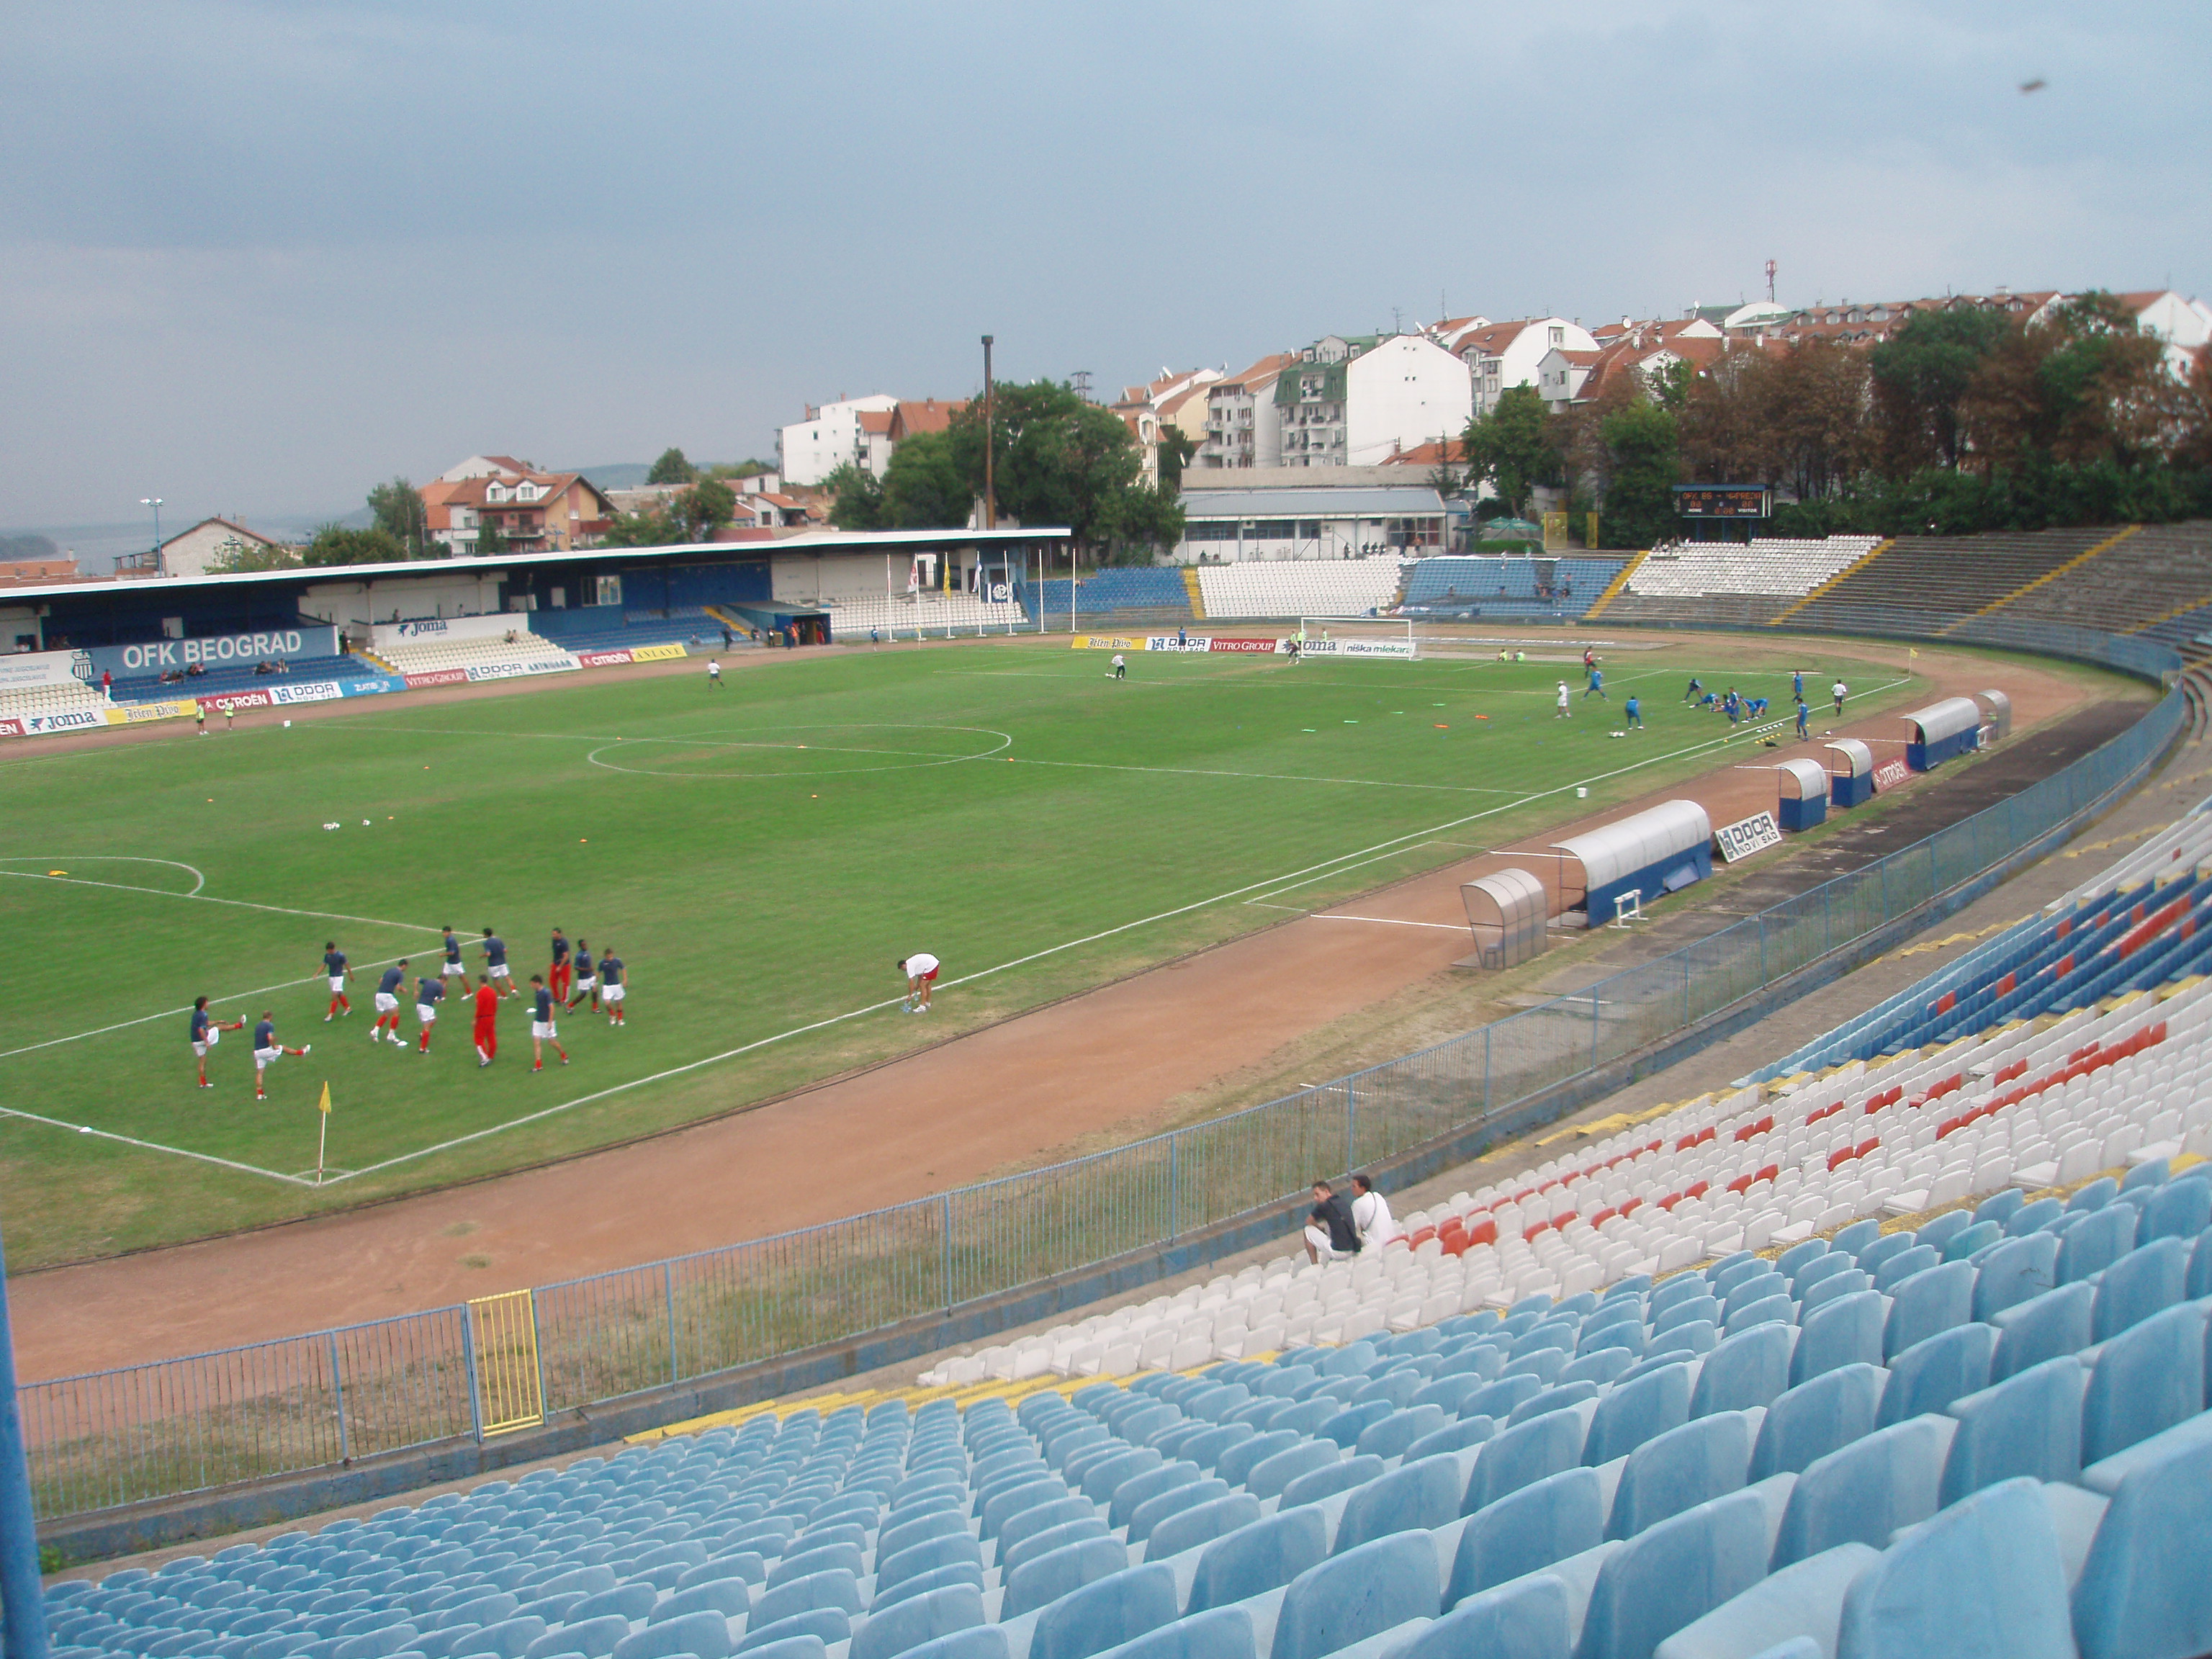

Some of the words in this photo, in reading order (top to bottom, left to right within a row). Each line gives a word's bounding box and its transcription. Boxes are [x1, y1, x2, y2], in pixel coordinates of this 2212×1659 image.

[1169, 638, 1206, 647] DOR
[1213, 640, 1240, 651] VITRO
[1241, 642, 1274, 651] GROUP
[1303, 640, 1337, 651] oma
[123, 642, 177, 668] OFK
[184, 631, 302, 662] BEOGRAD
[1738, 839, 1760, 853] NOVI
[1761, 832, 1778, 844] SAD
